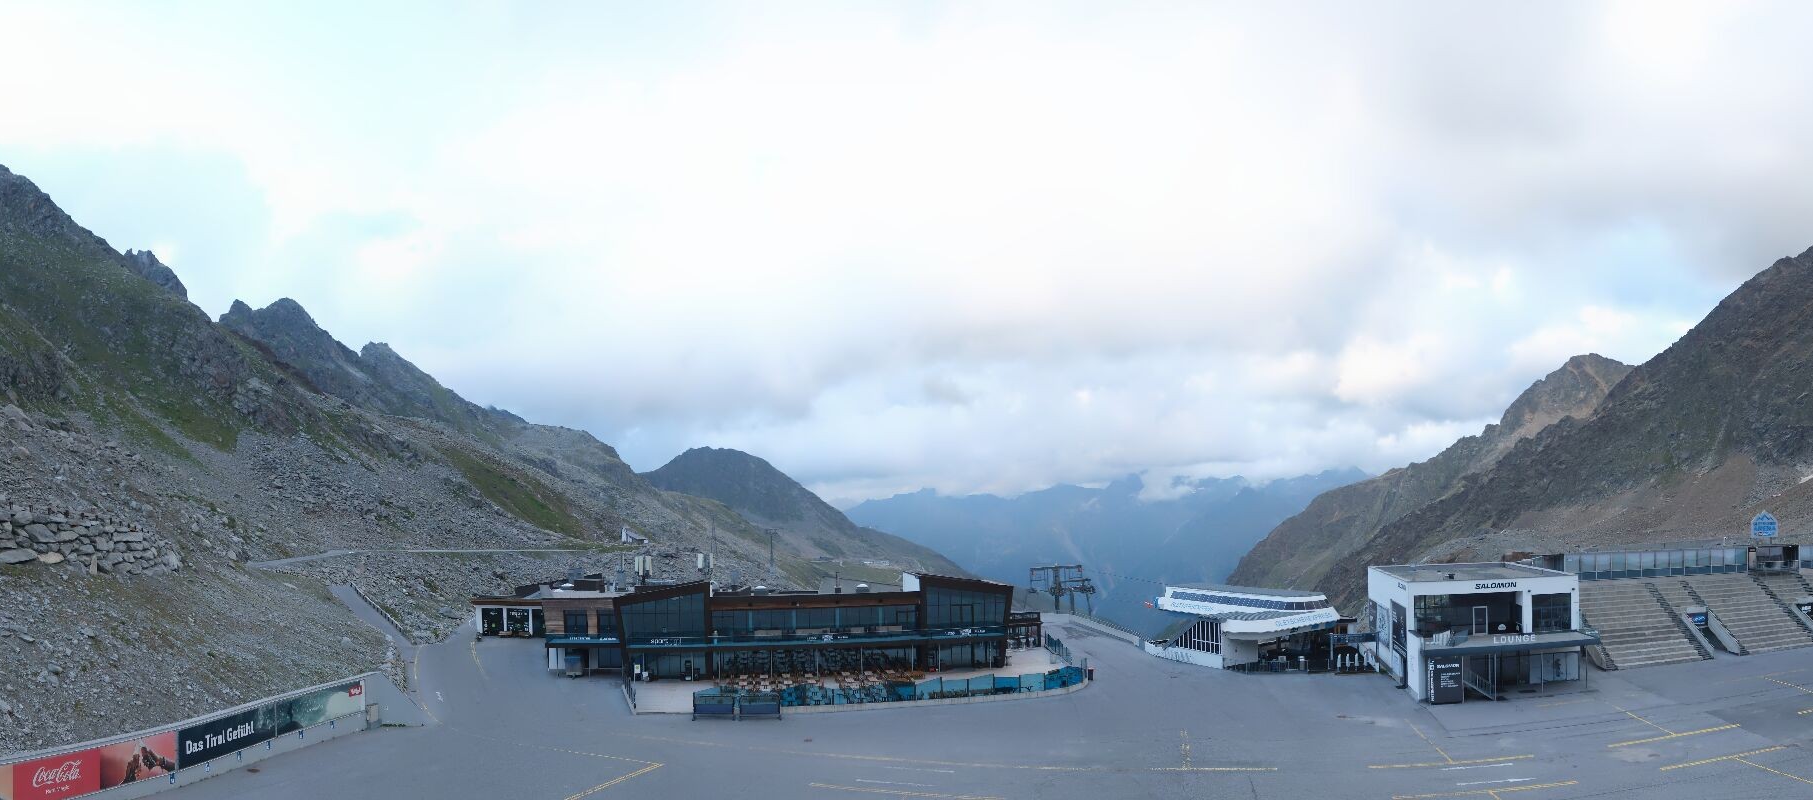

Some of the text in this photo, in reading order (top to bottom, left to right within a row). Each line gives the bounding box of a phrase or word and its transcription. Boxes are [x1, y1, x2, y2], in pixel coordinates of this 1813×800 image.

[1475, 582, 1517, 590] SALOMON
[1493, 634, 1536, 644] LOUNGE
[185, 720, 255, 755] Das Tirol Gefühl
